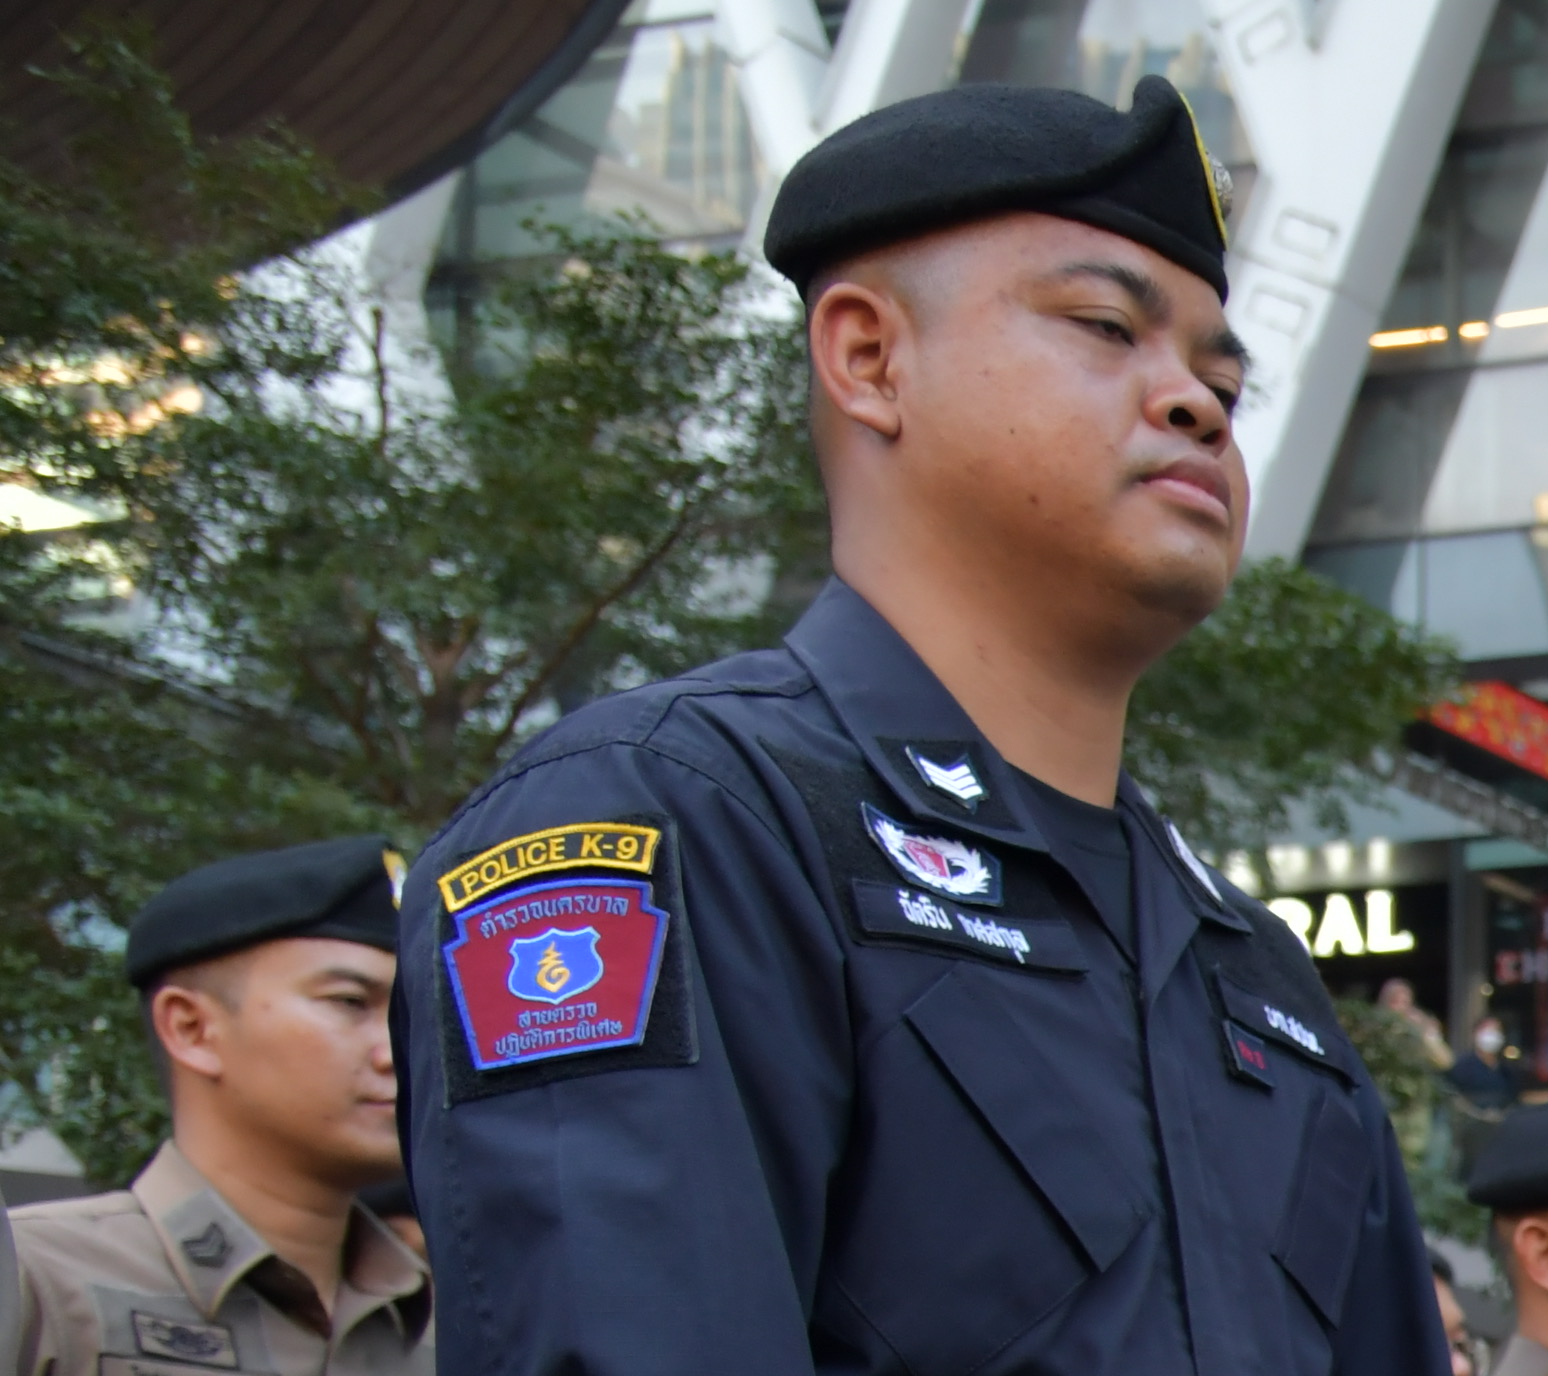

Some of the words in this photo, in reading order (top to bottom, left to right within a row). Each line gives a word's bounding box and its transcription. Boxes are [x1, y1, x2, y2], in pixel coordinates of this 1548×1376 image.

[460, 837, 566, 895] POLICE
[581, 834, 639, 860] K-9
[480, 895, 629, 939] ตำรวจนครบาล
[518, 1002, 598, 1028] สายตรวจ
[495, 1019, 623, 1057] ปฏิบัติการพิเศษ
